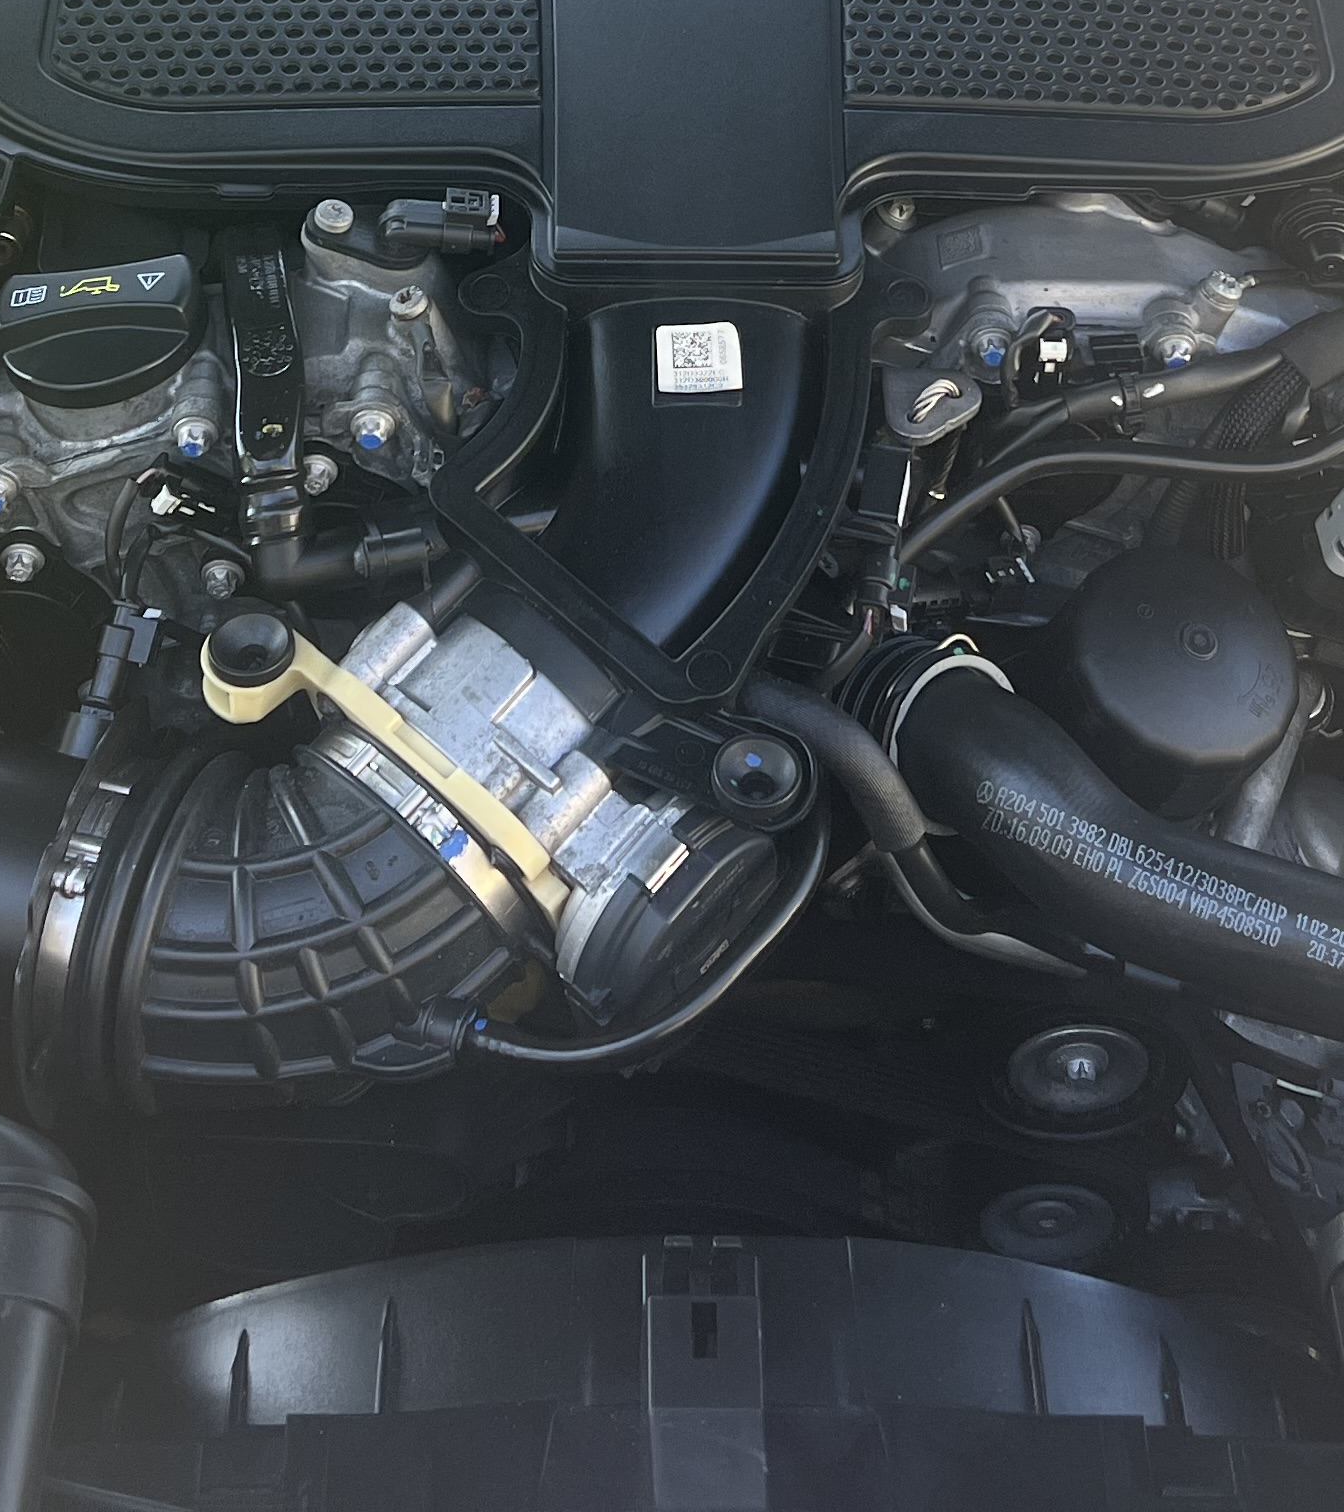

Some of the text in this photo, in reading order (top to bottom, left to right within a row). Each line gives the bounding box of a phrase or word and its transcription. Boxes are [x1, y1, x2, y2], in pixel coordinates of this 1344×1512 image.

[1037, 804, 1066, 831] 501
[1066, 816, 1107, 848] 3982
[1103, 858, 1124, 884] PL
[1127, 865, 1189, 908] ZGS004
